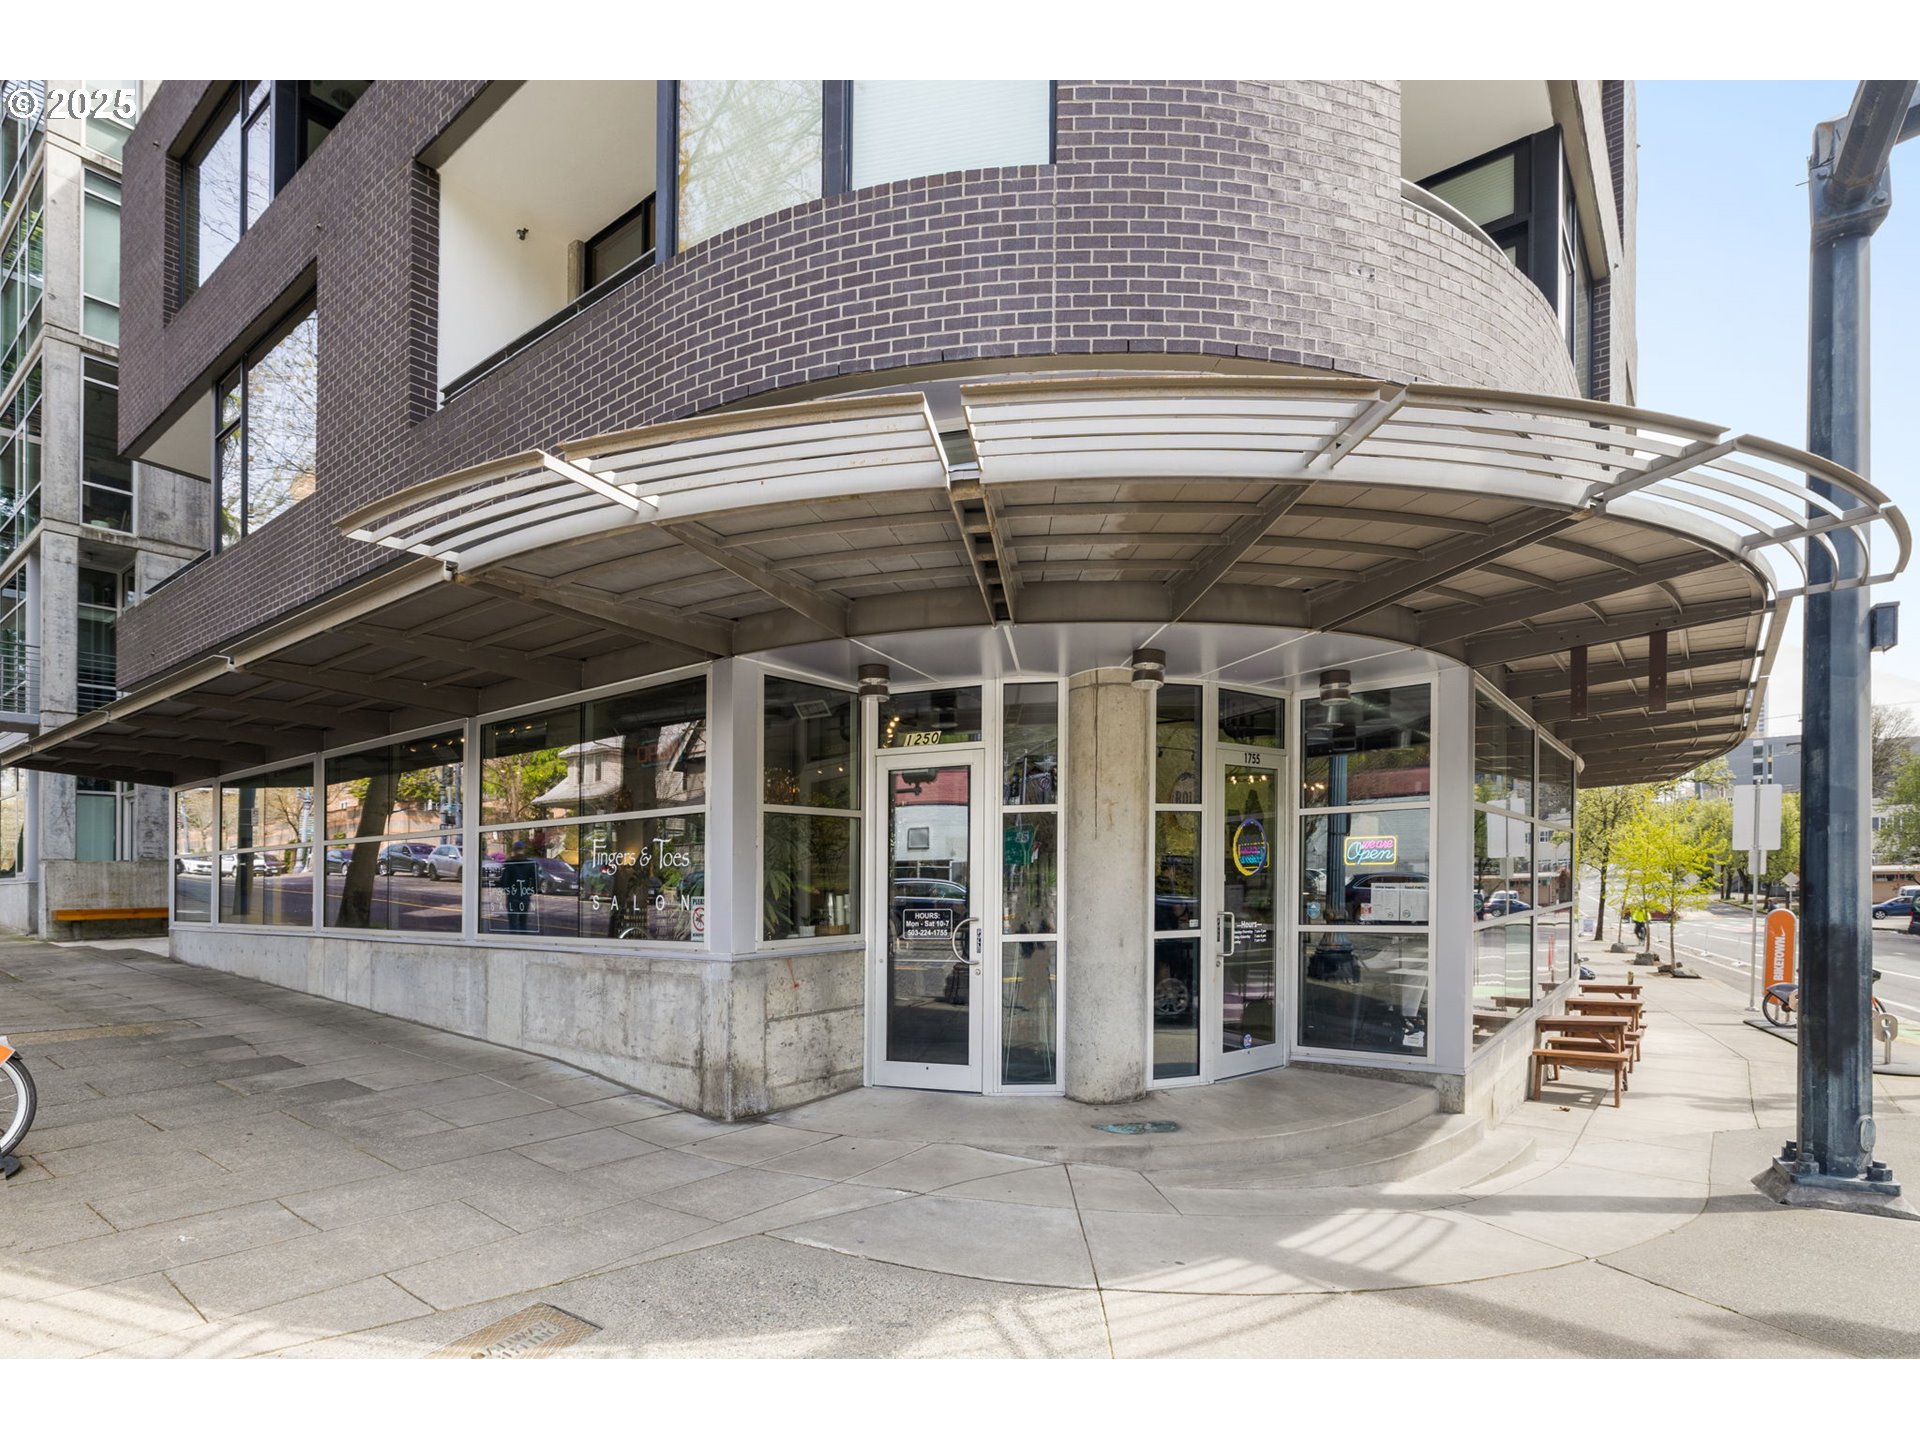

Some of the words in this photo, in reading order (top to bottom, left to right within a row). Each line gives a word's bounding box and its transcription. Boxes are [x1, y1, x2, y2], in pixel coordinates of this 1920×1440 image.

[907, 732, 939, 746] 1250
[1244, 752, 1261, 765] 1755
[1362, 840, 1376, 849] we
[1376, 839, 1394, 848] are
[591, 838, 637, 875] Fingers
[639, 846, 652, 867] &
[652, 838, 690, 869] Toes
[1347, 841, 1394, 864] Open
[592, 895, 690, 911] SALON
